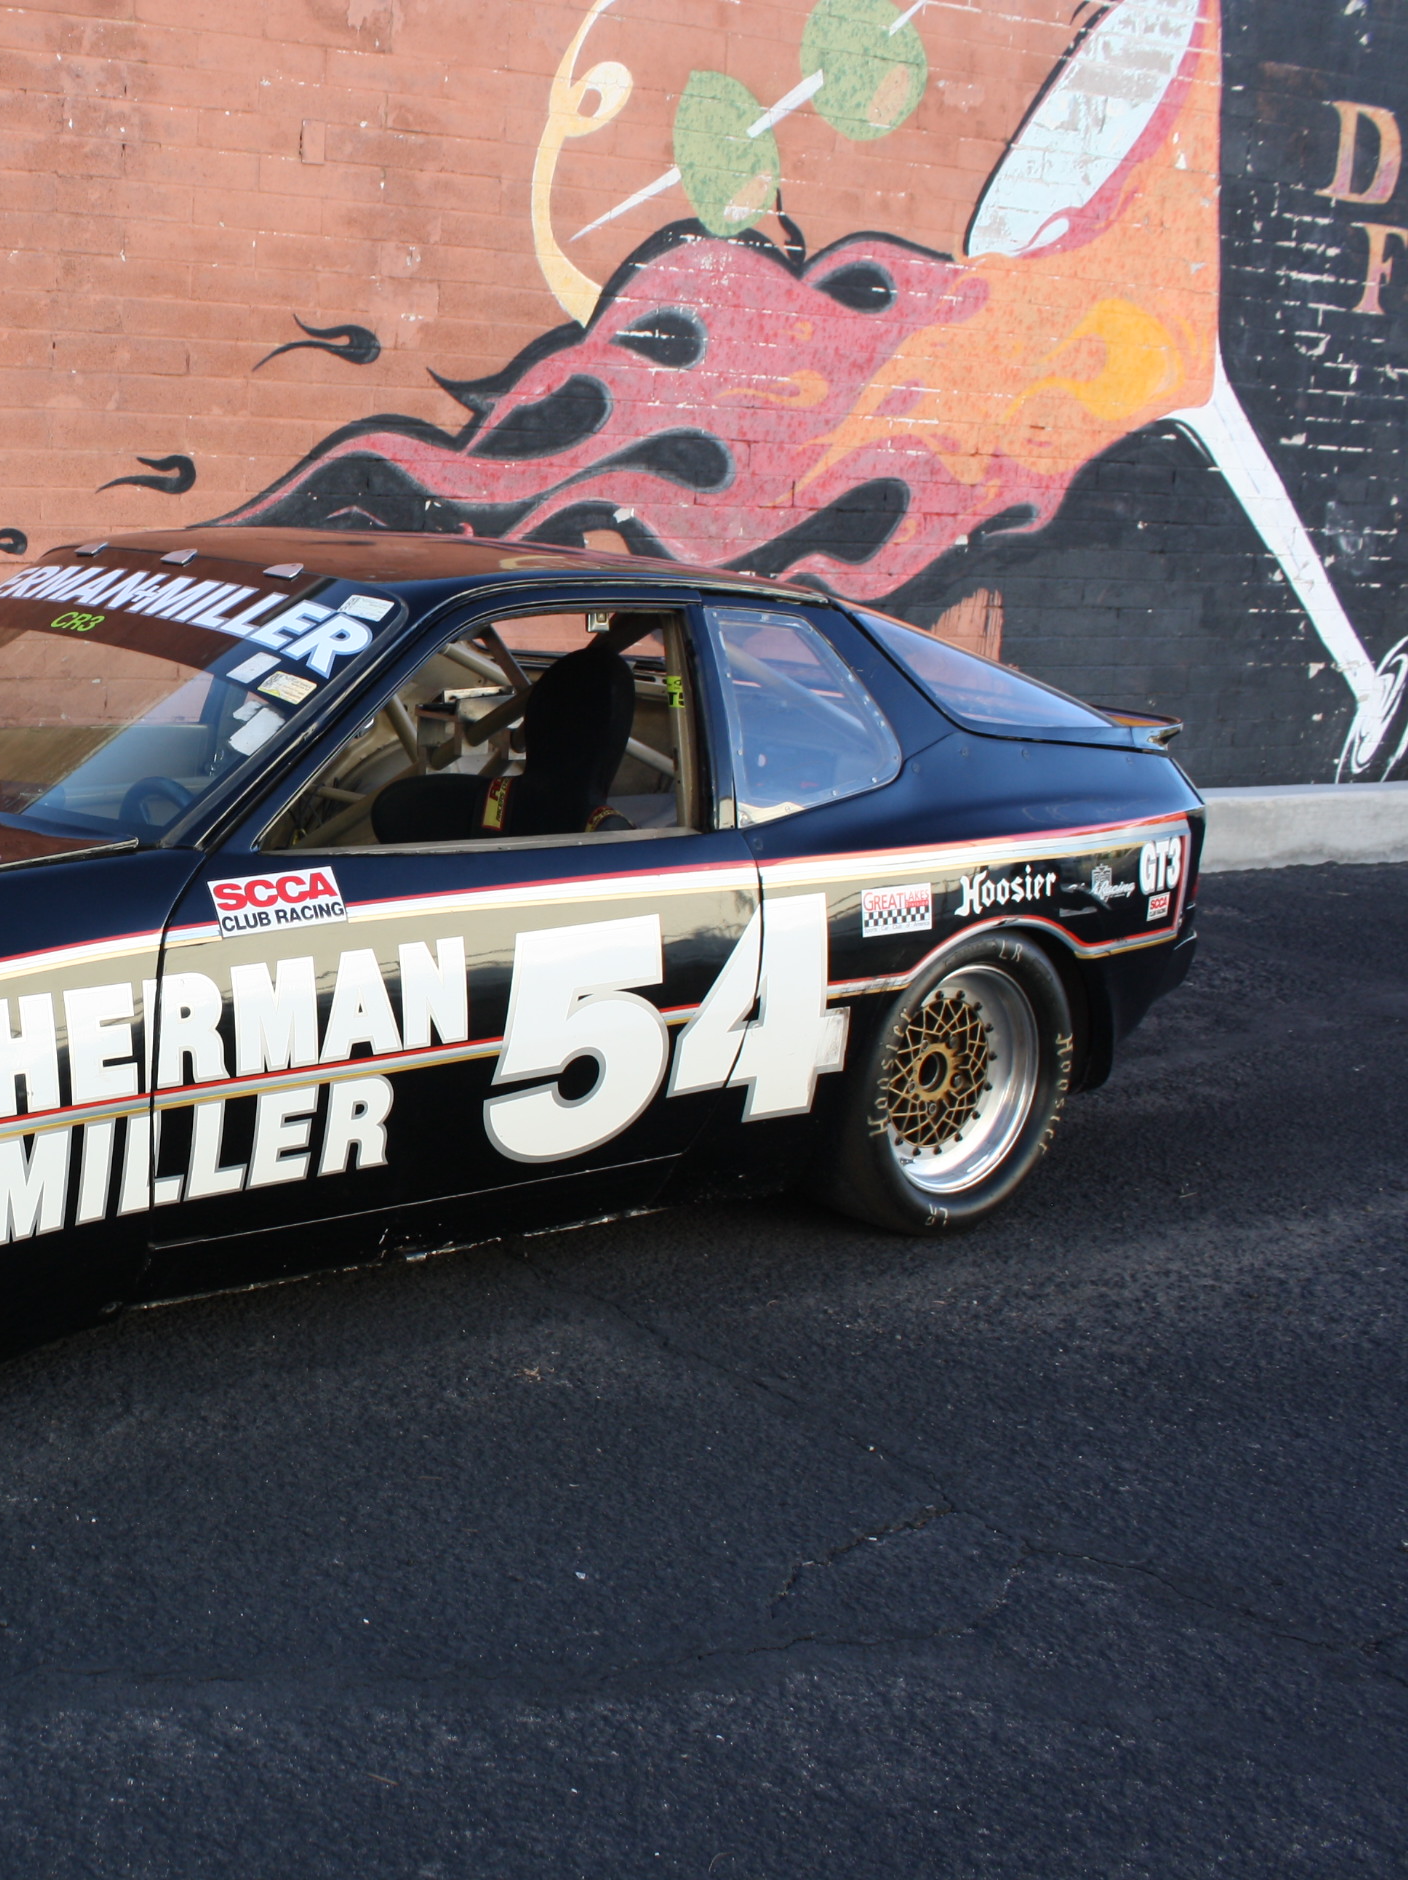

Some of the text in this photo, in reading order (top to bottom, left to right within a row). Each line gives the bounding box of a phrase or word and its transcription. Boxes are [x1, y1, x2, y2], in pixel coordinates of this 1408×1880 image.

[50, 611, 105, 632] CR3
[1139, 836, 1182, 896] GT3
[213, 872, 338, 911] SCCA
[863, 889, 930, 912] GREAT LAKES
[954, 864, 1057, 917] Hoosier
[221, 901, 344, 932] CLUB RACING
[483, 892, 851, 1164] 54
